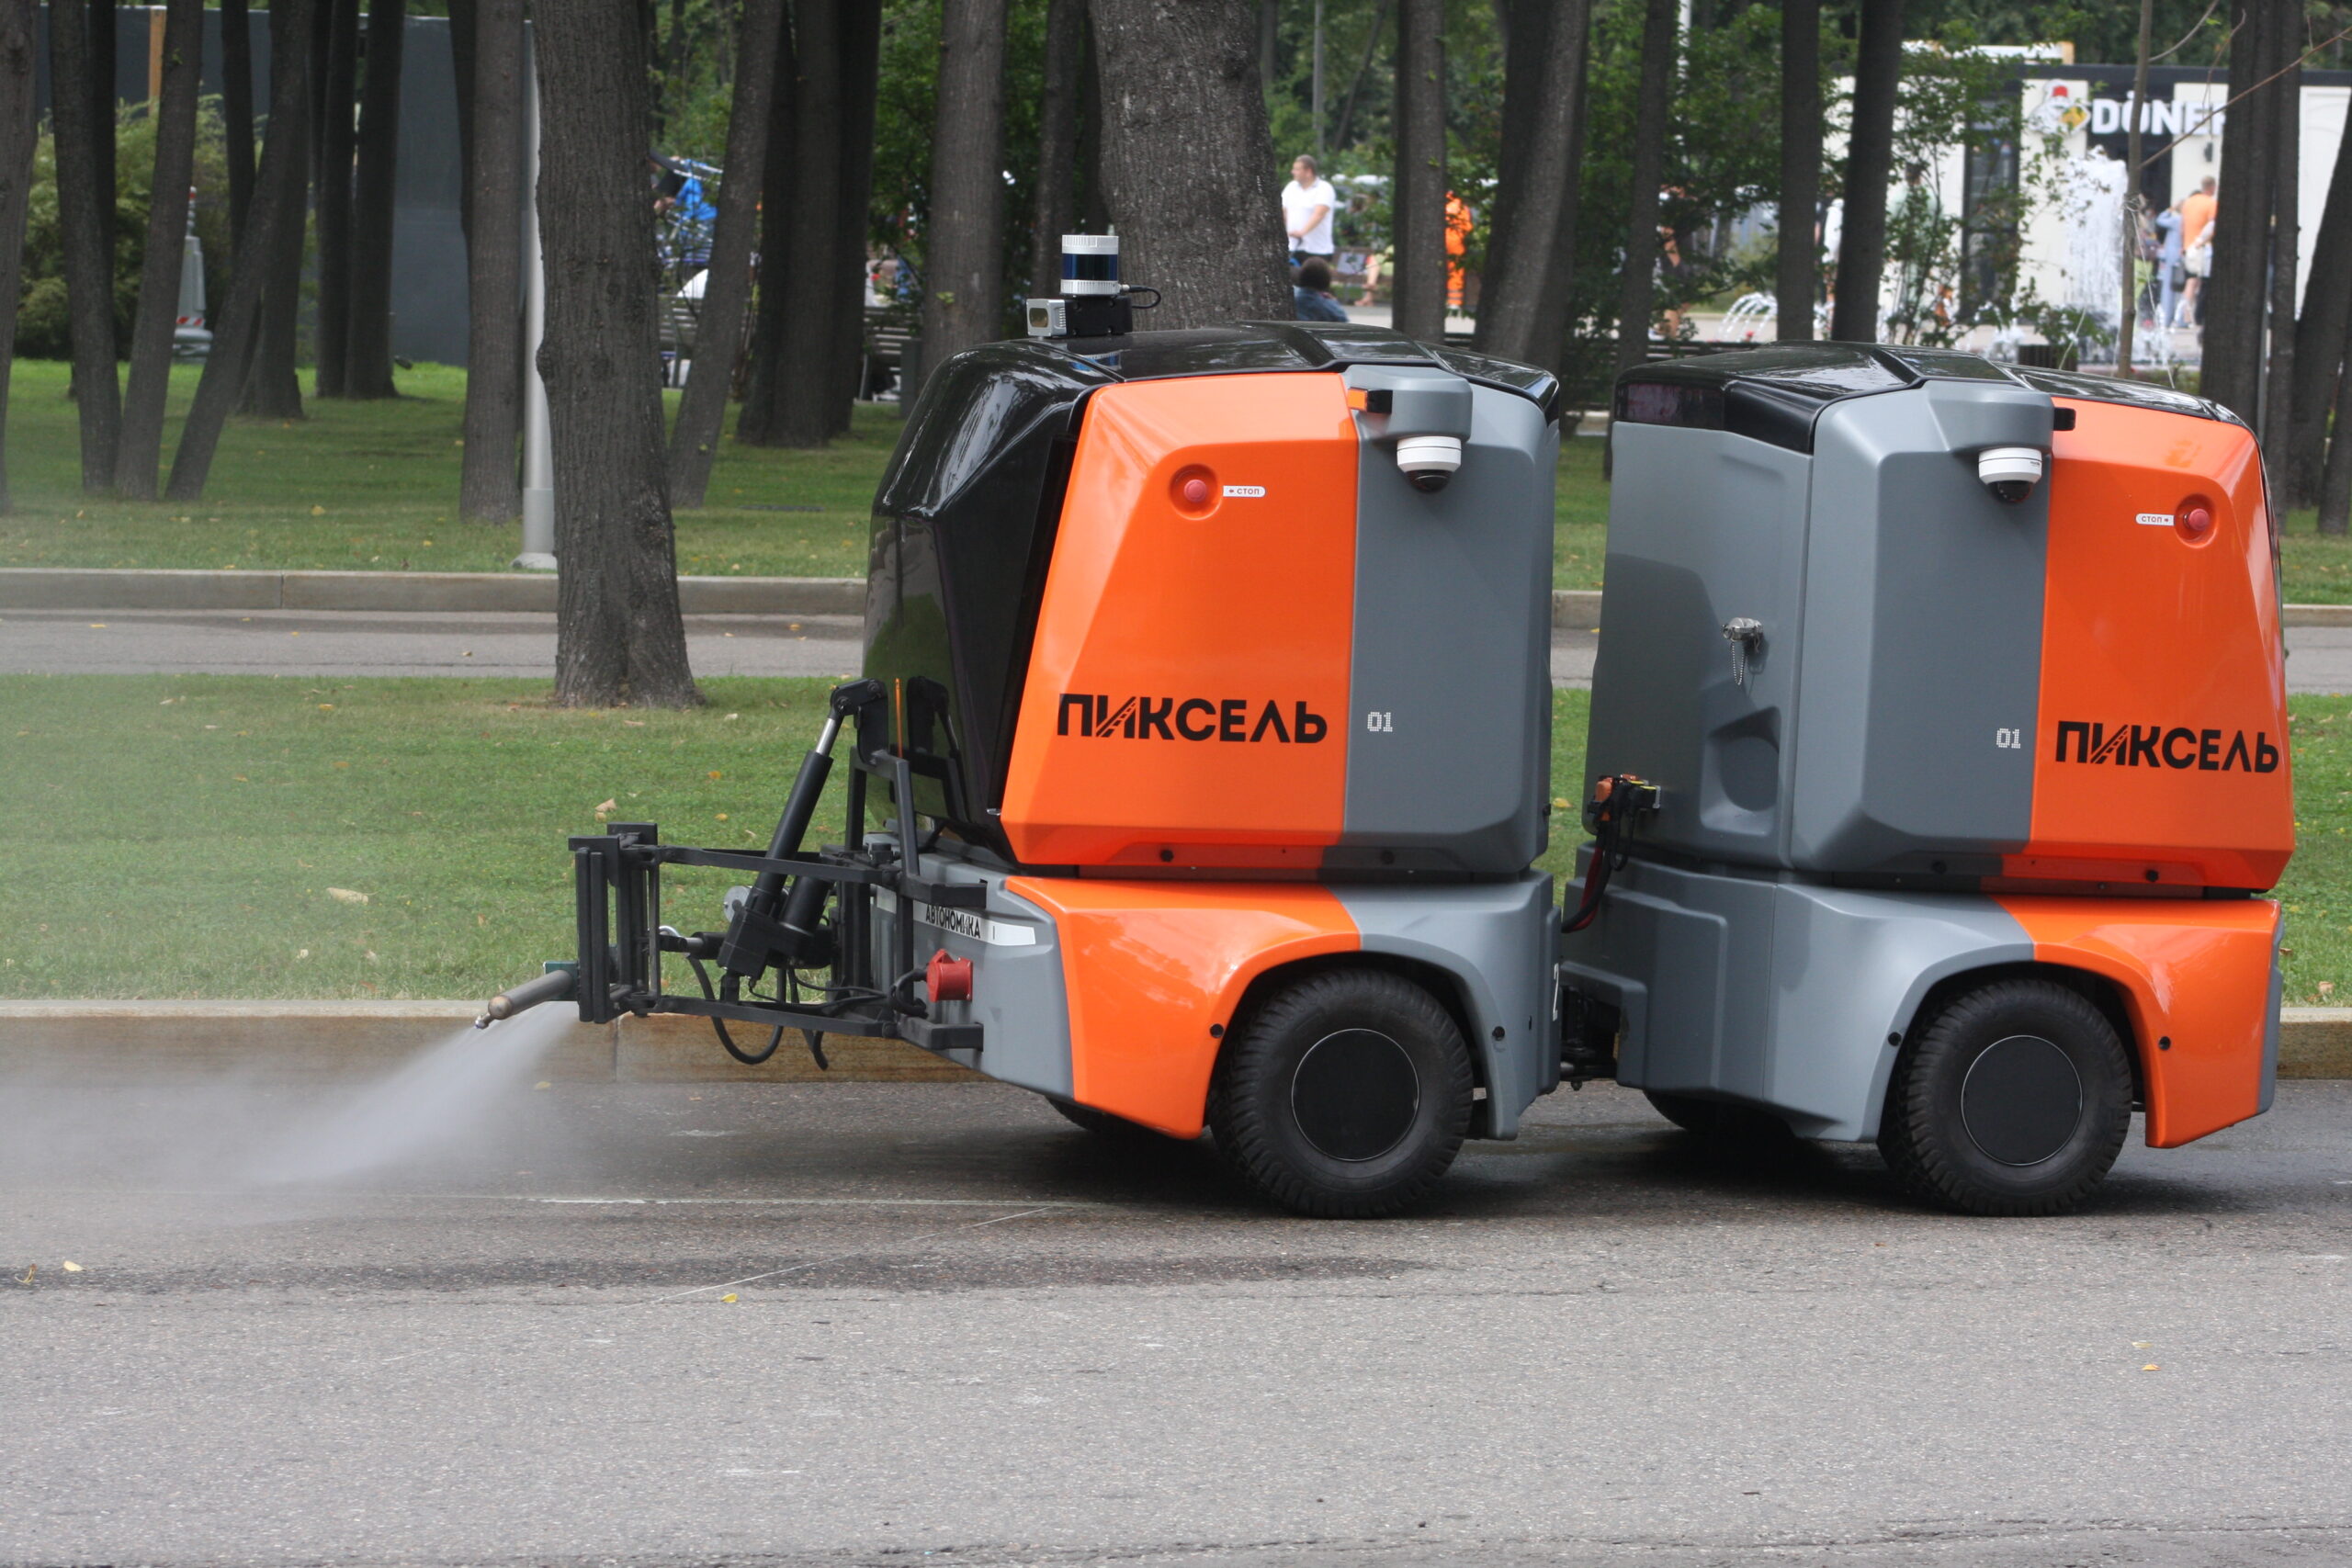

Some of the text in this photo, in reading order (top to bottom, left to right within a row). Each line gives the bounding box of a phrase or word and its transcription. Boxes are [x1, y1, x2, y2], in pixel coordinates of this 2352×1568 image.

[2141, 515, 2163, 524] СТОП
[1057, 693, 1329, 744] ПИКСЕЛЬ
[1367, 711, 1394, 733] 01
[1996, 728, 2021, 750] 01
[2055, 720, 2279, 774] ПИКСЕЛЬ
[926, 904, 981, 939] АВТОНОМИКА
